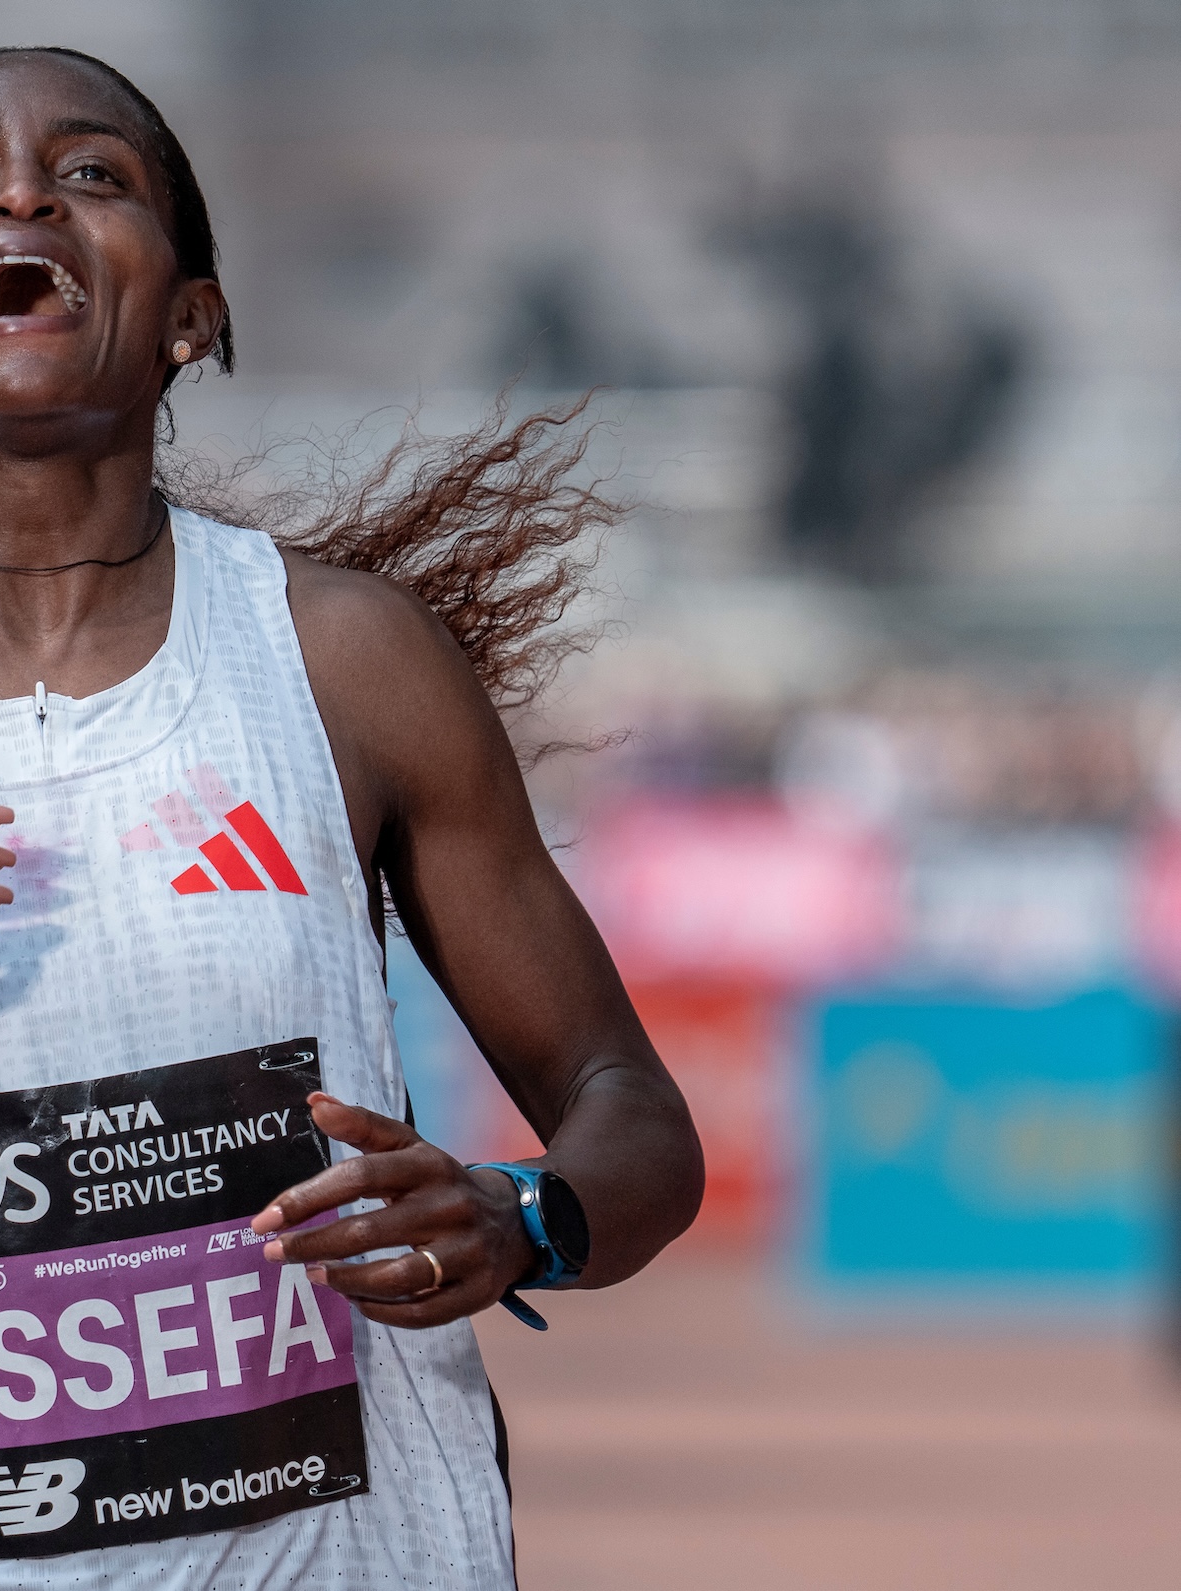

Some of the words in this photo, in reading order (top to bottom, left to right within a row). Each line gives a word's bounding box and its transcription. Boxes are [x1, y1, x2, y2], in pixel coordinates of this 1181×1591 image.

[62, 1101, 165, 1141] TATA
[68, 1108, 291, 1178] CONSULTANCY
[73, 1163, 224, 1216] SERVICES
[34, 1243, 187, 1278] #WeRunTogether
[95, 1486, 172, 1524] new
[180, 1455, 326, 1512] balance
